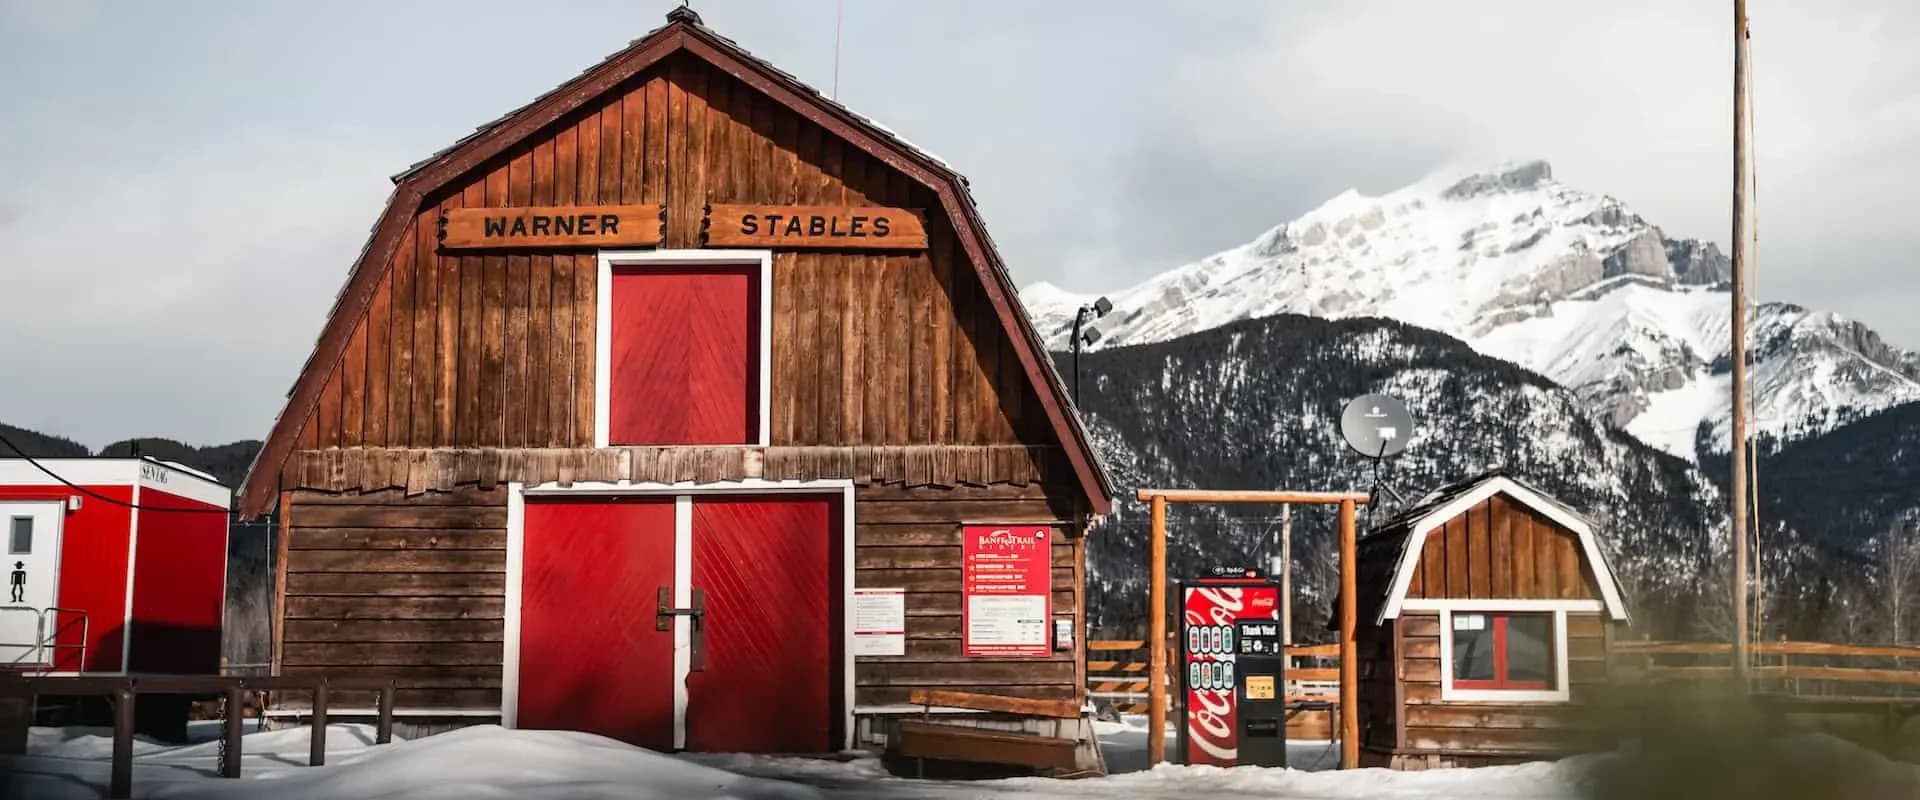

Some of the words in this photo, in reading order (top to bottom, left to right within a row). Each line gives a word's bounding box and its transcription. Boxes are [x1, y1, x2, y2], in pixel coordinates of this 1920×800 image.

[484, 214, 620, 237] WARNER
[741, 213, 891, 238] STABLES
[1242, 624, 1261, 635] Thank
